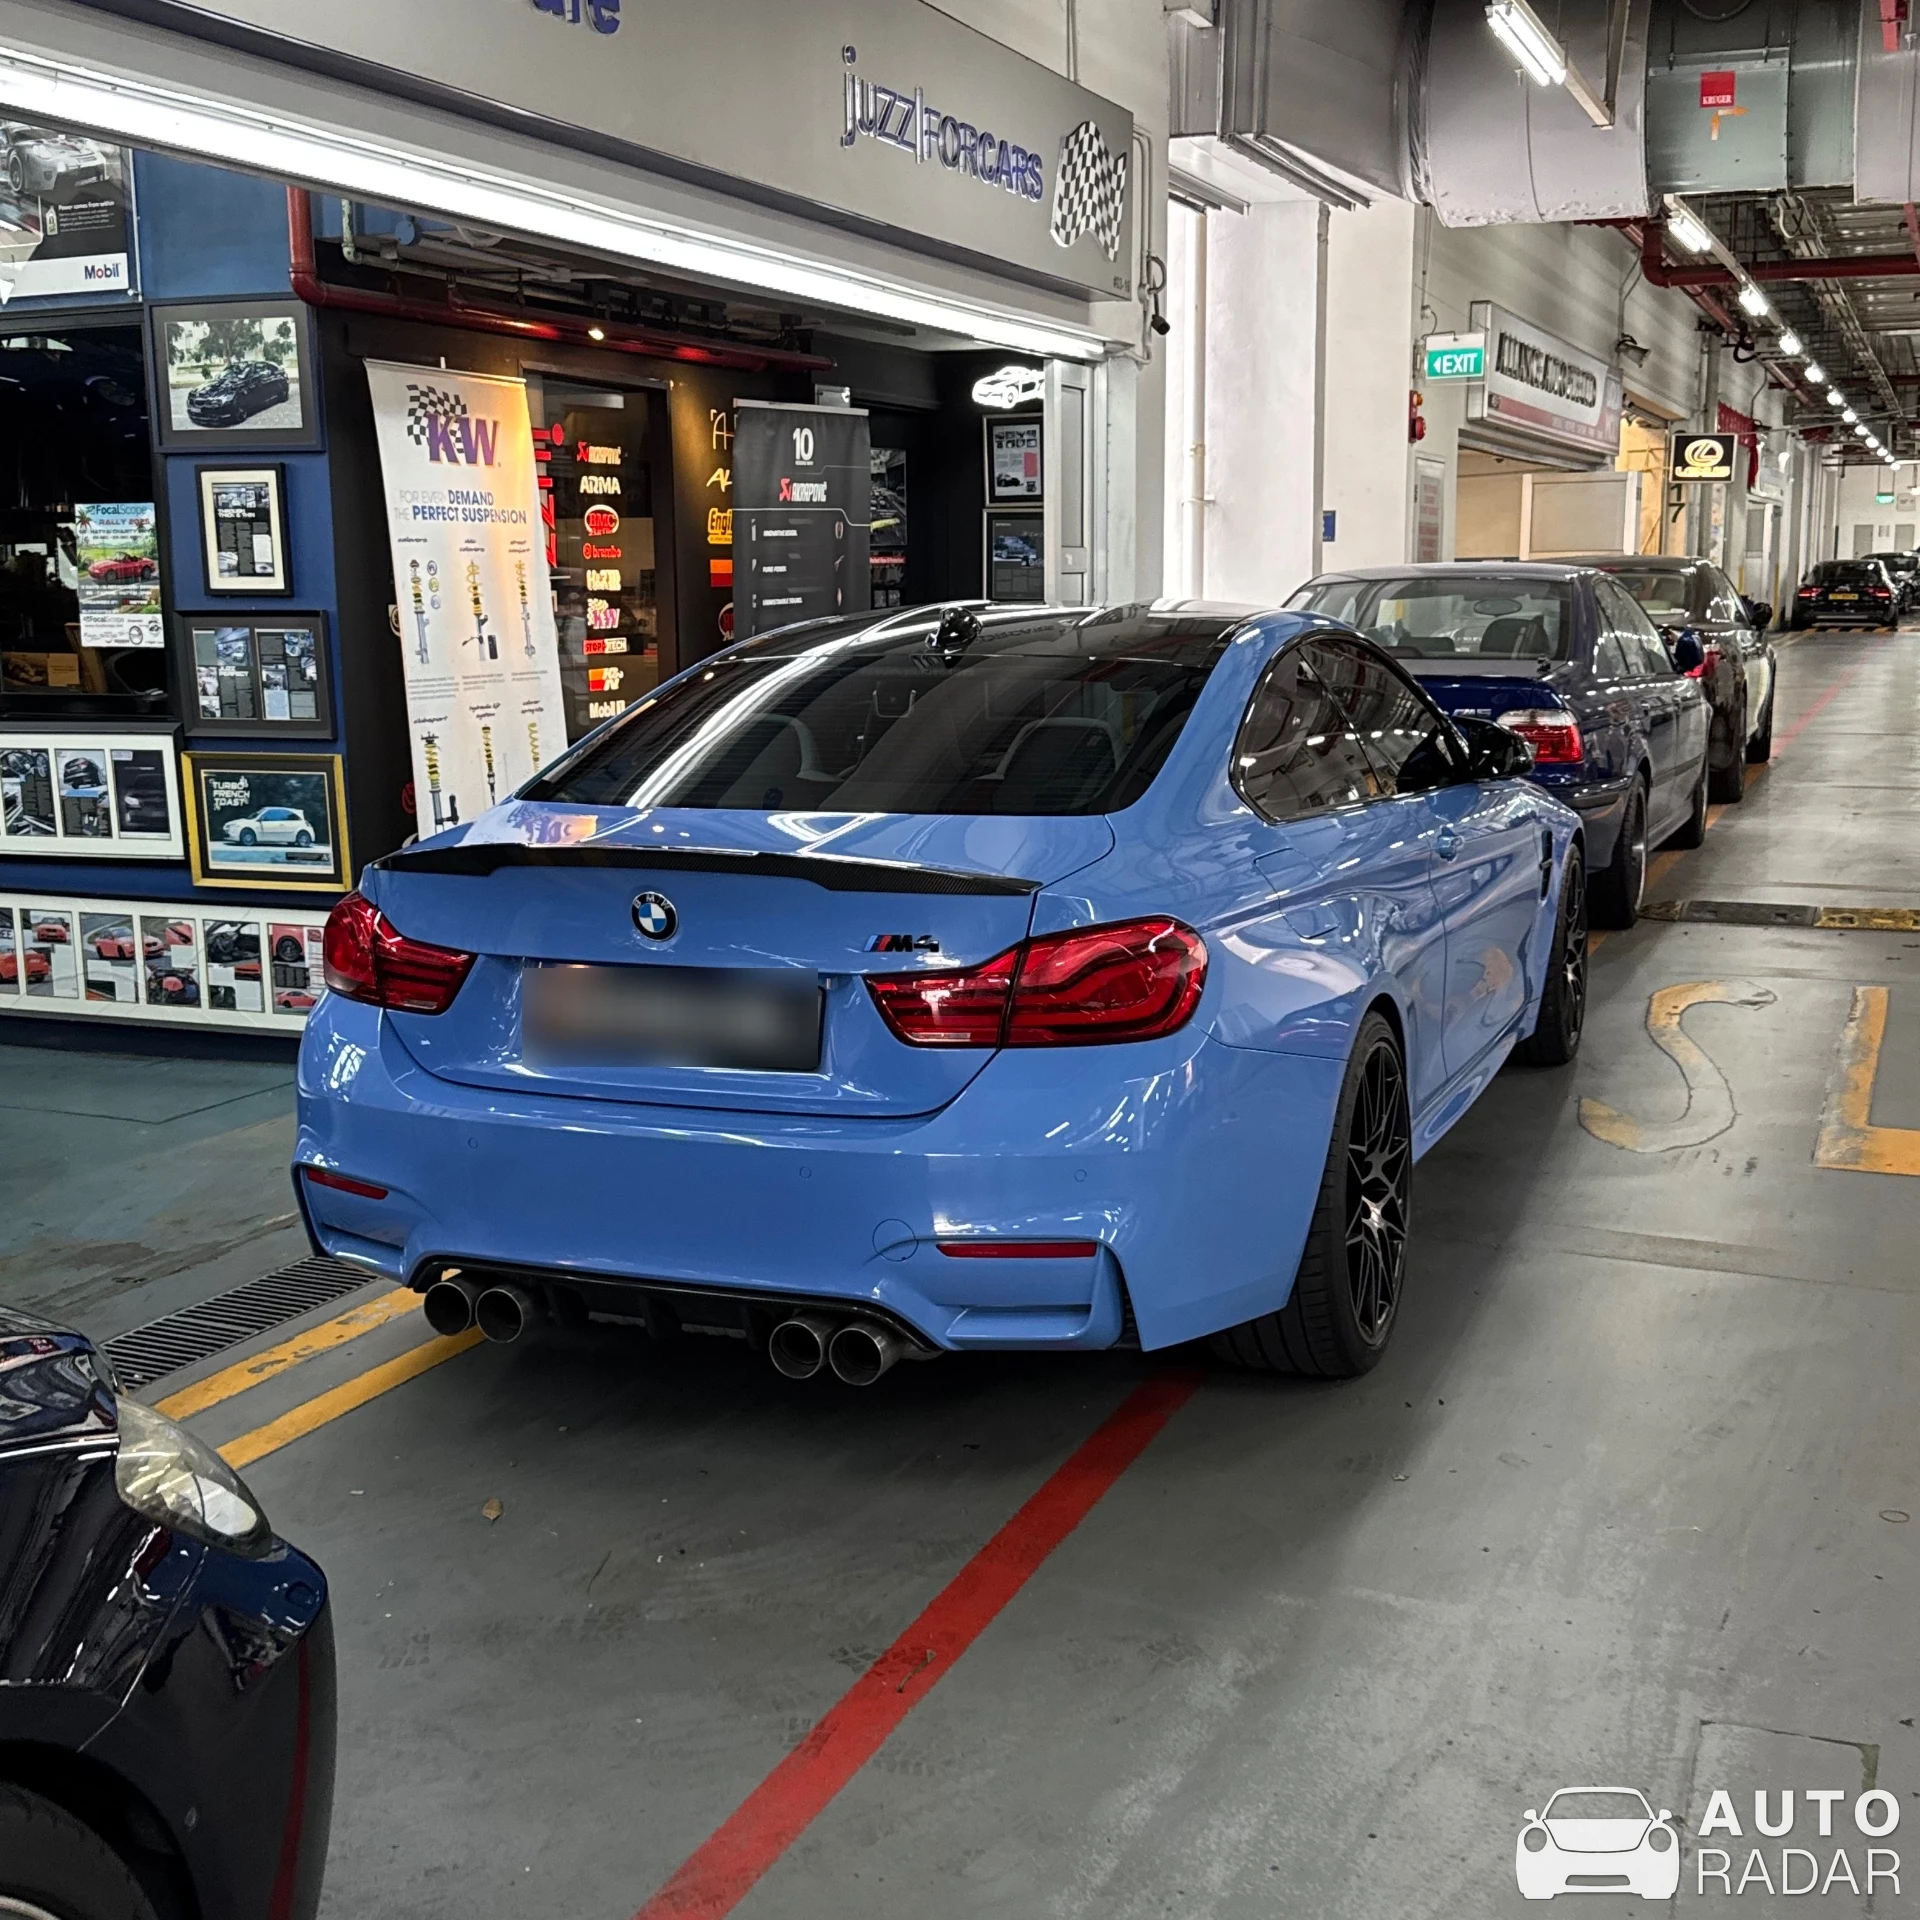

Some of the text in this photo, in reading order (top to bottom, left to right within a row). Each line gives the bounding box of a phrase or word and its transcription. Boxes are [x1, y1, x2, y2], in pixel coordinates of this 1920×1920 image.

[84, 263, 120, 280] Mobil
[1442, 353, 1477, 374] EXIT
[427, 412, 500, 469] KW
[792, 427, 814, 461] 10
[579, 475, 622, 495] ARMA
[448, 489, 495, 506] DEMAND
[96, 504, 148, 516] FocalScope
[412, 505, 460, 522] PERFECT
[461, 507, 528, 524] SUSPENSION
[588, 512, 616, 528] BMC
[589, 701, 615, 719] Mobil
[212, 781, 246, 790] TURBO
[213, 789, 250, 798] FRENCH
[213, 798, 245, 807] TOAST
[863, 934, 940, 953] M4
